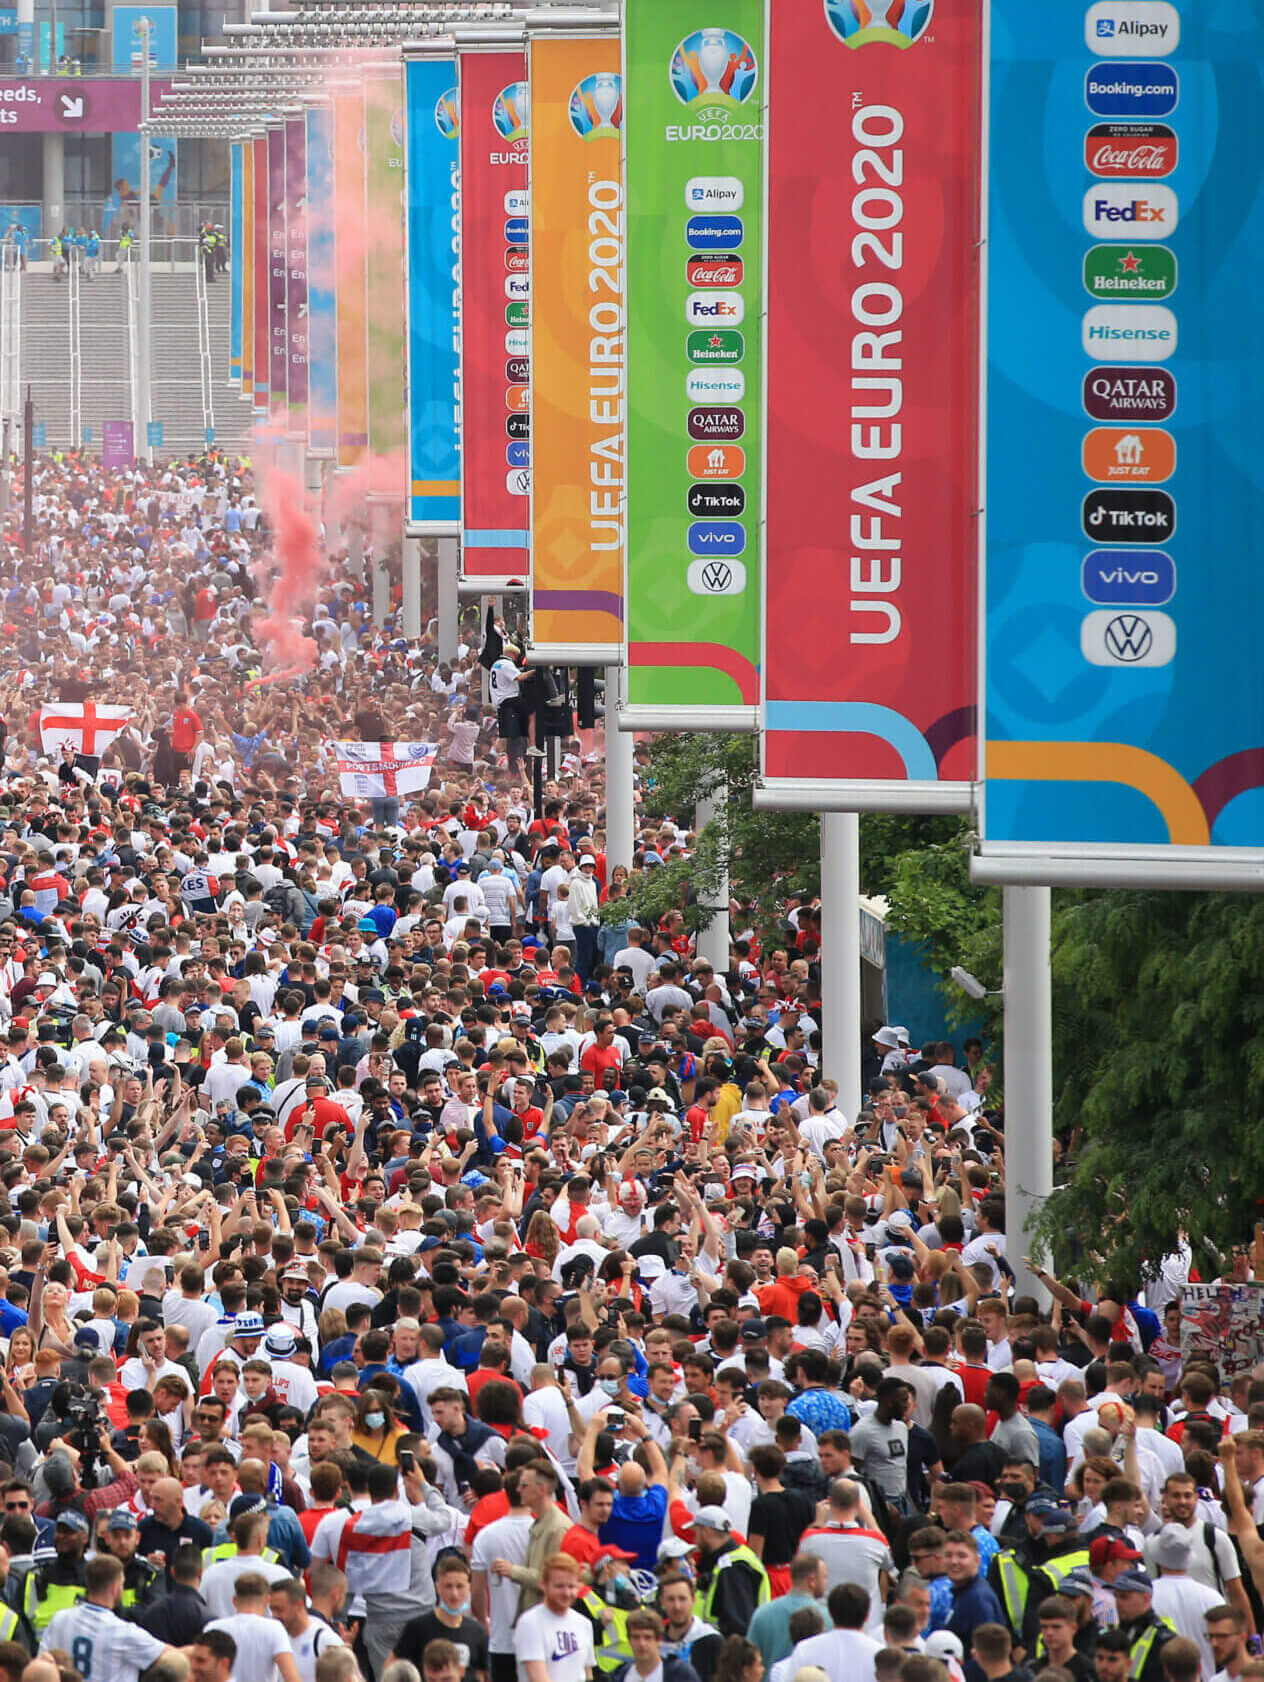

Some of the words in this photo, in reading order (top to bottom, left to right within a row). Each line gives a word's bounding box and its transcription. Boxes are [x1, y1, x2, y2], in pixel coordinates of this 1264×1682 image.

[1118, 21, 1168, 38] Alipay
[1089, 82, 1174, 97] Booking.com
[705, 189, 737, 200] Alipay
[1095, 200, 1165, 222] FedEx
[688, 228, 741, 238] Booking.com
[1093, 275, 1166, 290] Heineken
[693, 302, 736, 316] FedEx
[1088, 326, 1171, 341] Hisense
[692, 349, 738, 359] Heineken
[589, 302, 625, 424] EURO
[851, 283, 904, 459] EURO
[690, 381, 742, 390] Hisense
[1092, 379, 1165, 399] QATAR
[1110, 397, 1167, 409] AIRWAYS
[692, 414, 738, 427] QATAR
[703, 425, 739, 433] AIRWAYS
[1107, 466, 1130, 475] JUST
[1131, 466, 1151, 476] EAT
[589, 432, 625, 551] UEFA
[704, 496, 741, 507] TikTok
[1109, 510, 1168, 527] TikTok
[698, 532, 736, 543] vivo
[849, 471, 903, 645] UEFA
[1099, 567, 1159, 584] vivo
[73, 1636, 93, 1679] 8
